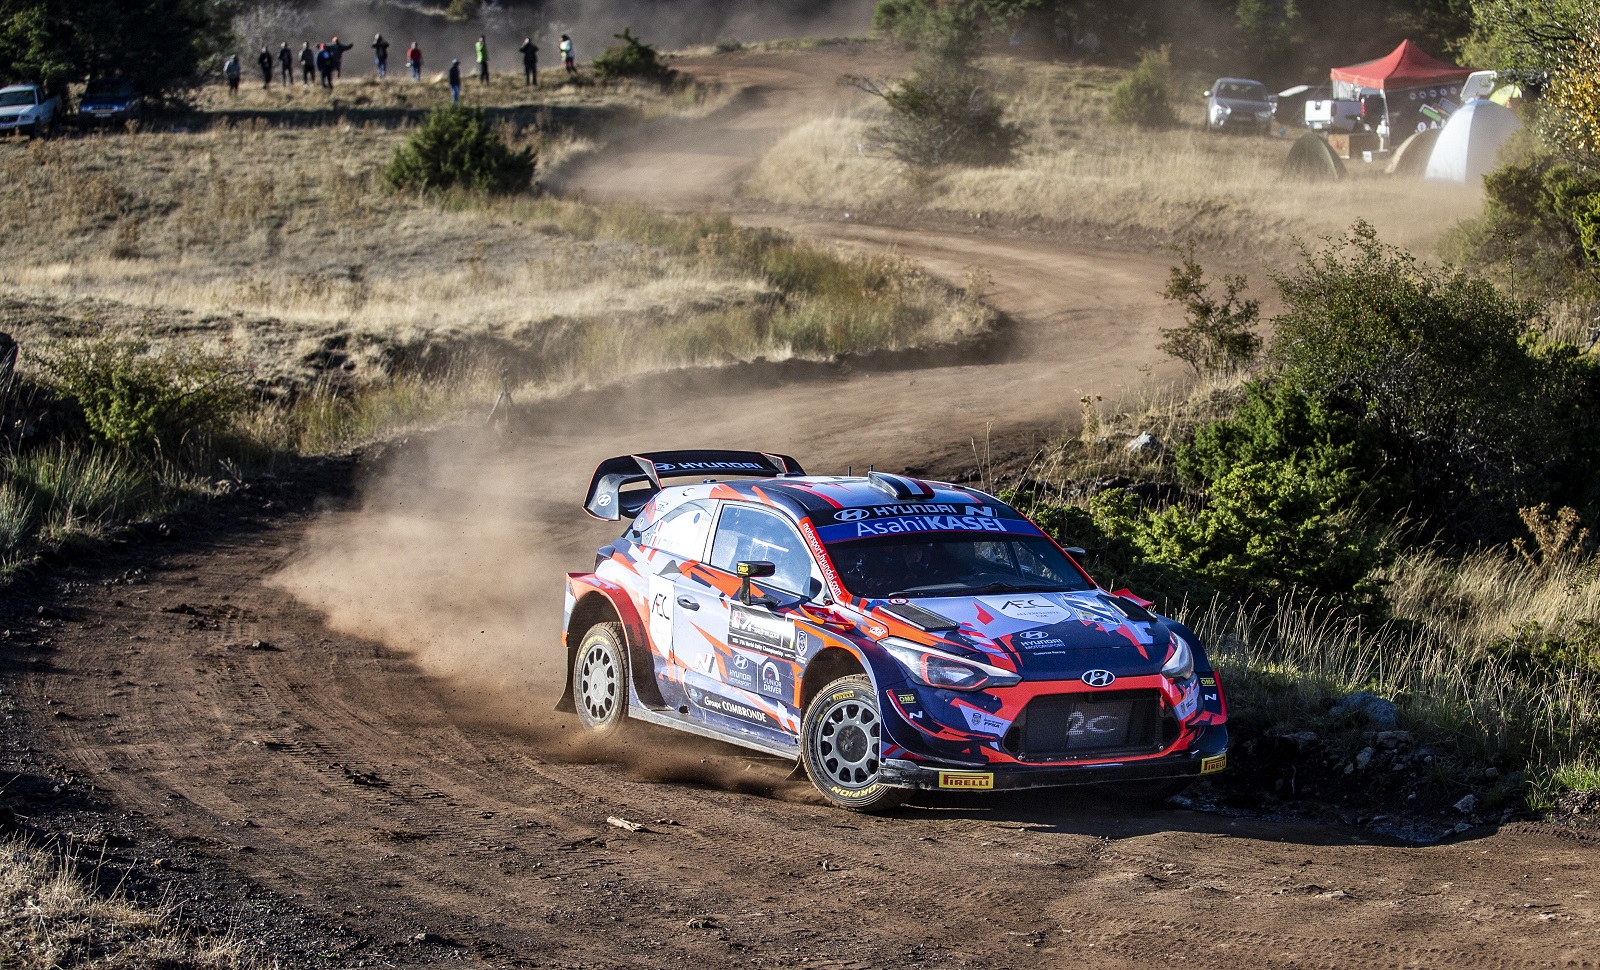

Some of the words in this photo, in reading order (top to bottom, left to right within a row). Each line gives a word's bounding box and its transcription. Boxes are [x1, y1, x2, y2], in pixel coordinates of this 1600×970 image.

[874, 504, 958, 516] HYUNDAI
[802, 522, 842, 597] motorsport.hyundai.com
[1021, 639, 1063, 647] HYUNDAI
[763, 679, 782, 689] JUNIOR
[763, 684, 782, 695] DRIVER
[704, 696, 721, 709] Groupe
[722, 701, 767, 722] COMBRONDE
[1204, 756, 1226, 771] PIRELLI
[943, 775, 989, 786] PIRELLI
[831, 783, 880, 798] ORPION
